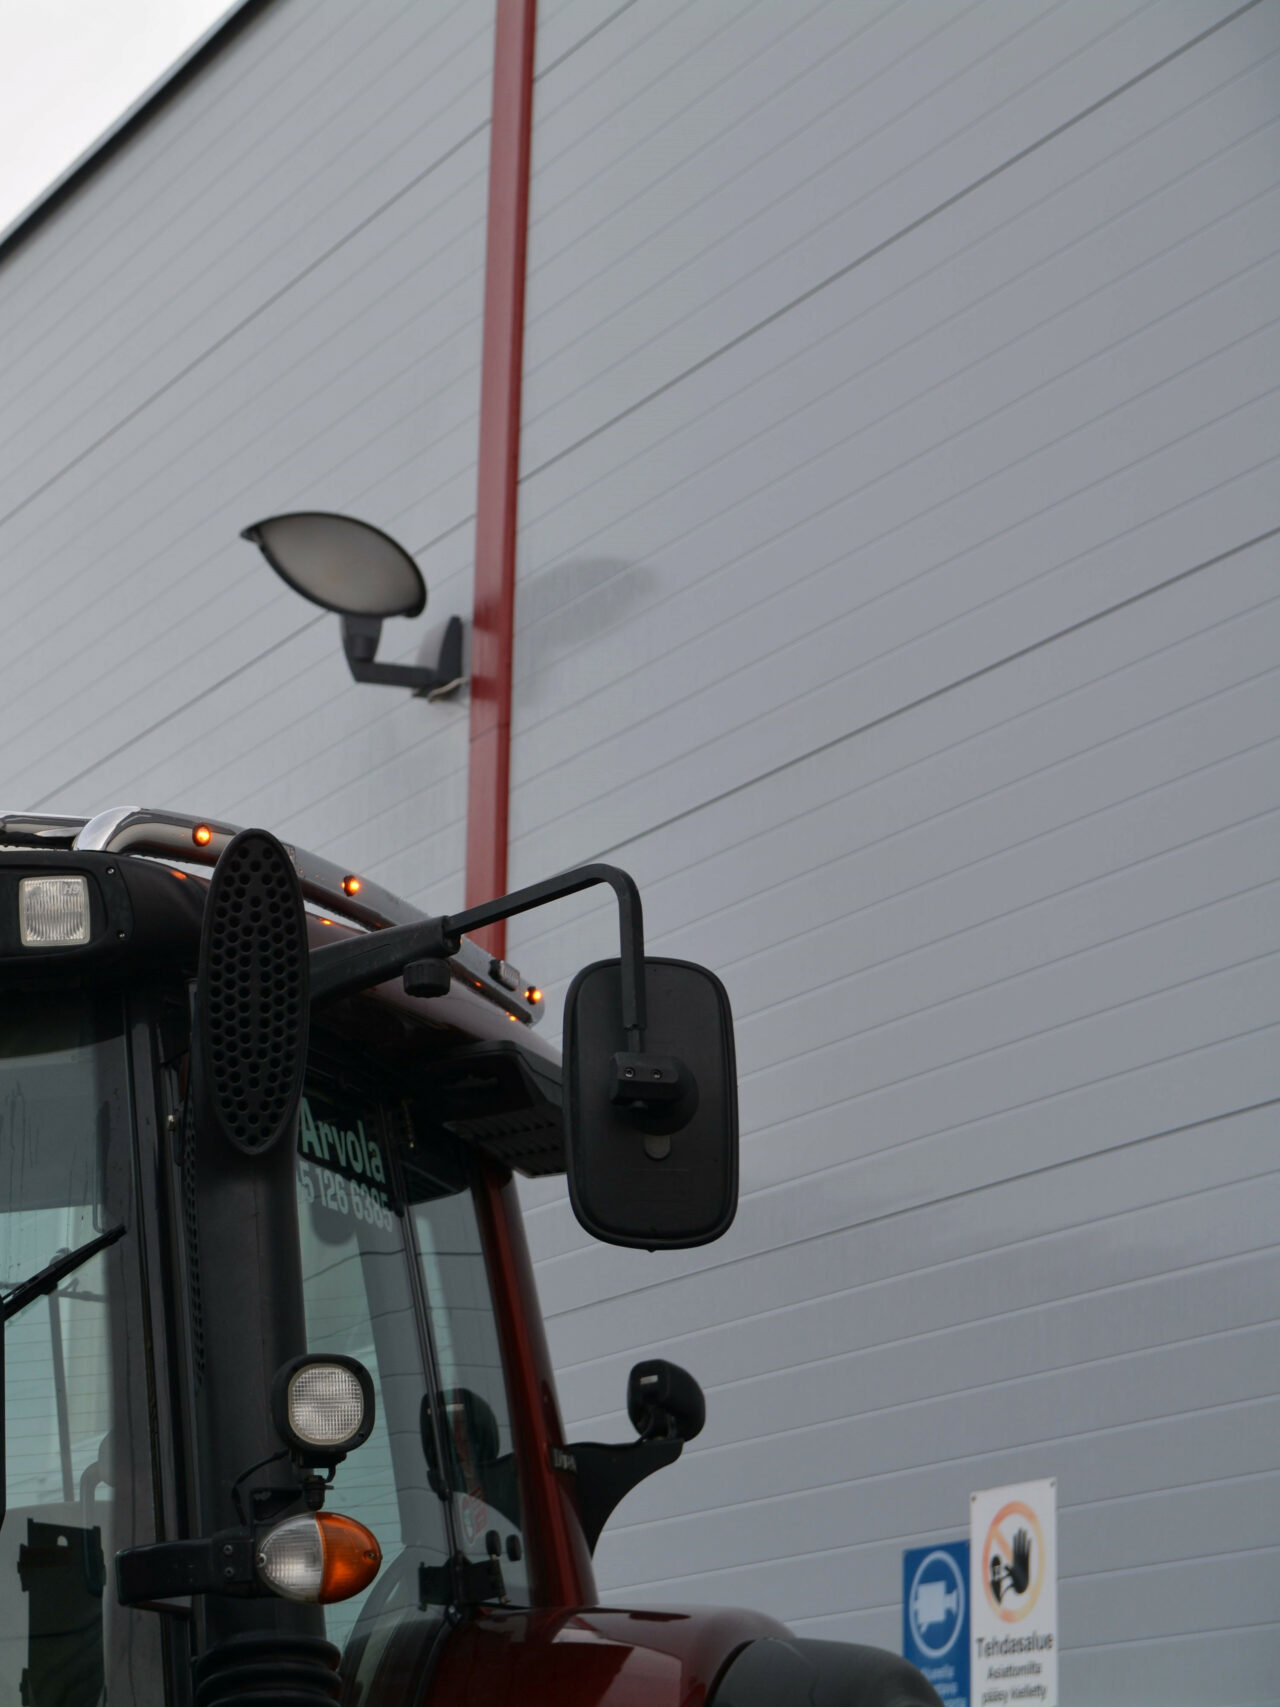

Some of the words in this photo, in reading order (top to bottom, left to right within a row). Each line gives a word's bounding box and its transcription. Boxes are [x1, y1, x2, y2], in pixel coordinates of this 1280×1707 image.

[300, 1096, 385, 1184] Arvola
[315, 1167, 348, 1215] 126
[350, 1179, 393, 1233] 6385
[975, 1631, 1054, 1659] Tehdasalue
